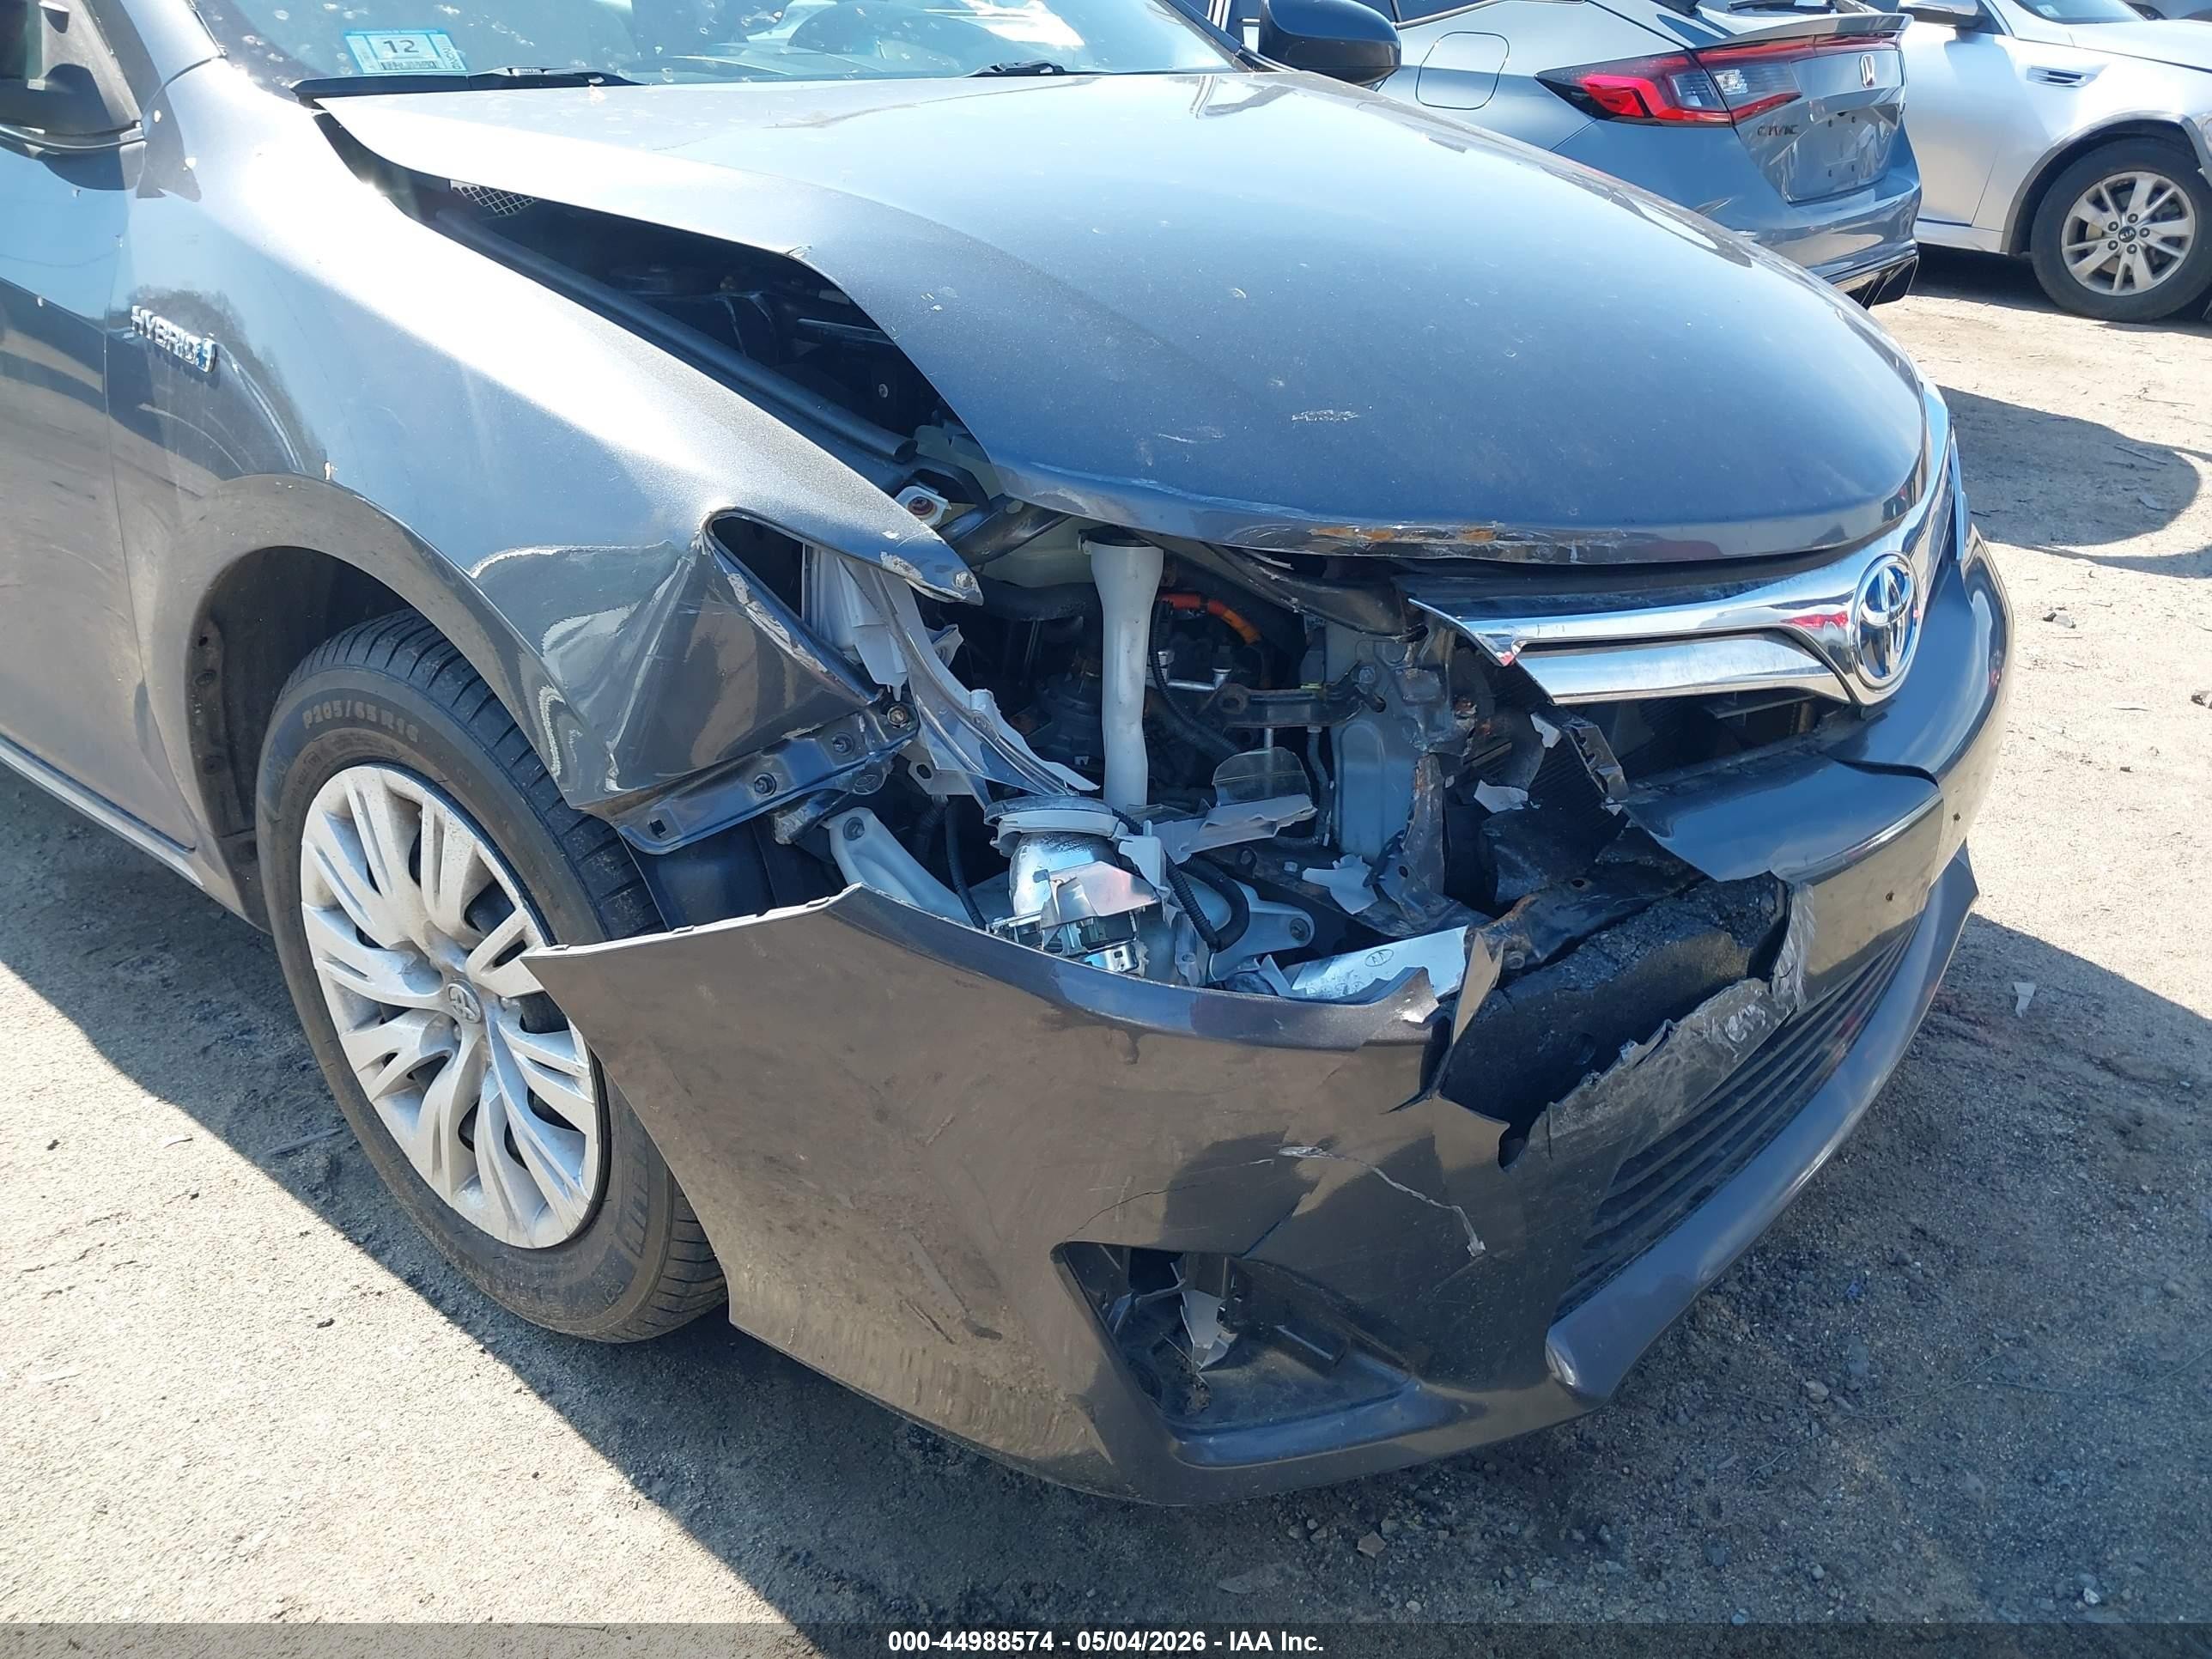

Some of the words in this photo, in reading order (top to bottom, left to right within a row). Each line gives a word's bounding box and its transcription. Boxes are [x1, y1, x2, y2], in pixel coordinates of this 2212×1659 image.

[383, 40, 419, 53] 12
[1757, 124, 1798, 136] CIVIC
[131, 305, 199, 364] HYBRID
